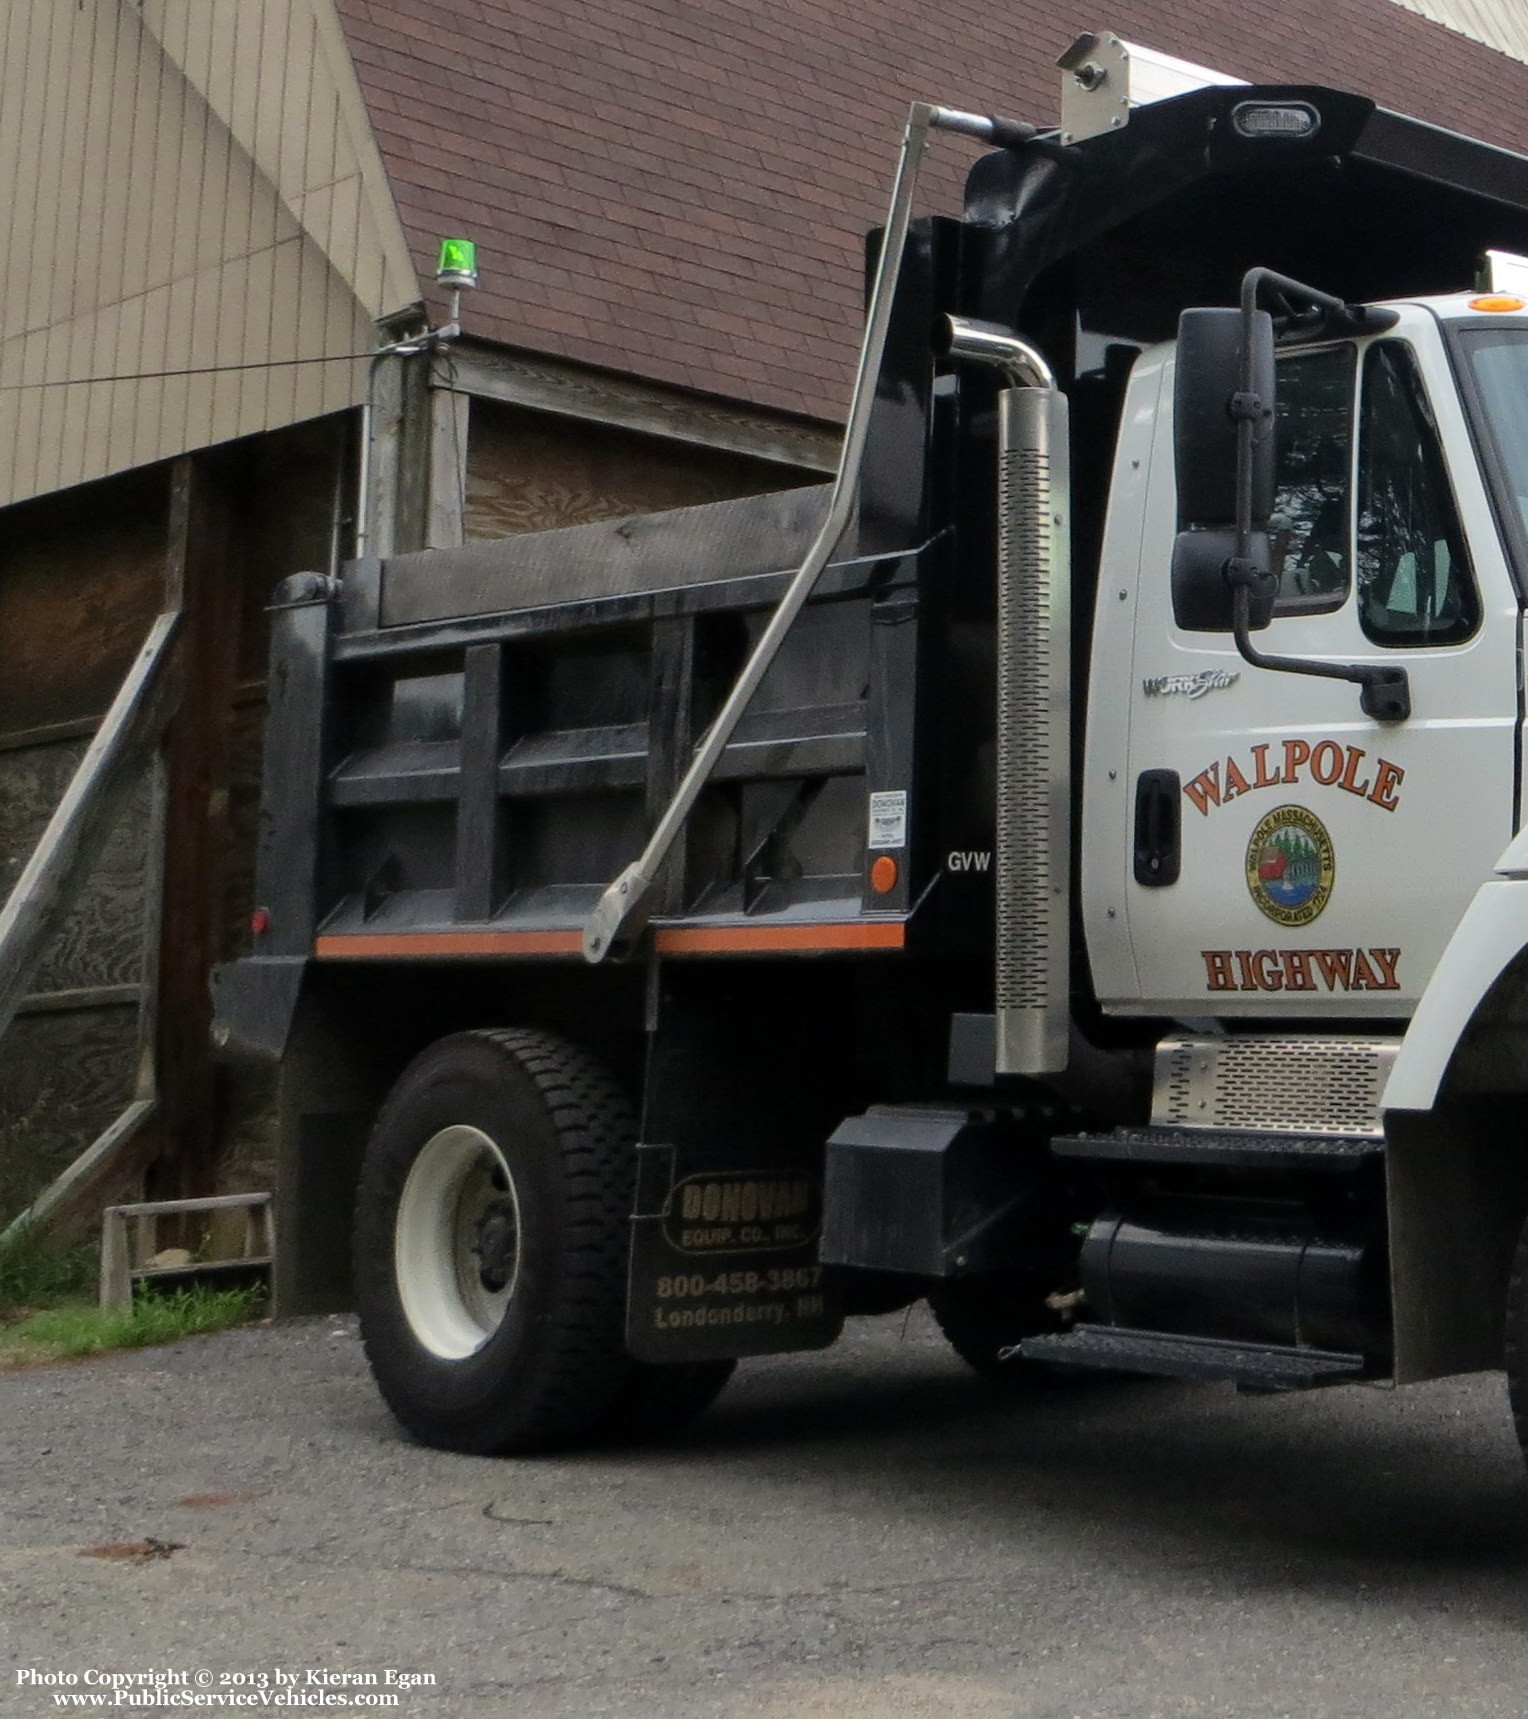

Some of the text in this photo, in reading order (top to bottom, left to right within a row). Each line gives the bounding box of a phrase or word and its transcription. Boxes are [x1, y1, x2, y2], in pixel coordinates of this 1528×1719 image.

[1183, 739, 1405, 817] WALPOLE
[1248, 808, 1332, 872] WALPOLE MASSACHUSETTS
[948, 851, 991, 871] GVW
[1253, 885, 1314, 922] INCORPORATED
[1200, 948, 1401, 992] HIGHWAY
[681, 1179, 809, 1222] DONOVAN
[681, 1227, 736, 1247] EQUIP.
[657, 1266, 823, 1298] 800-458-3867
[797, 1295, 824, 1317] NH
